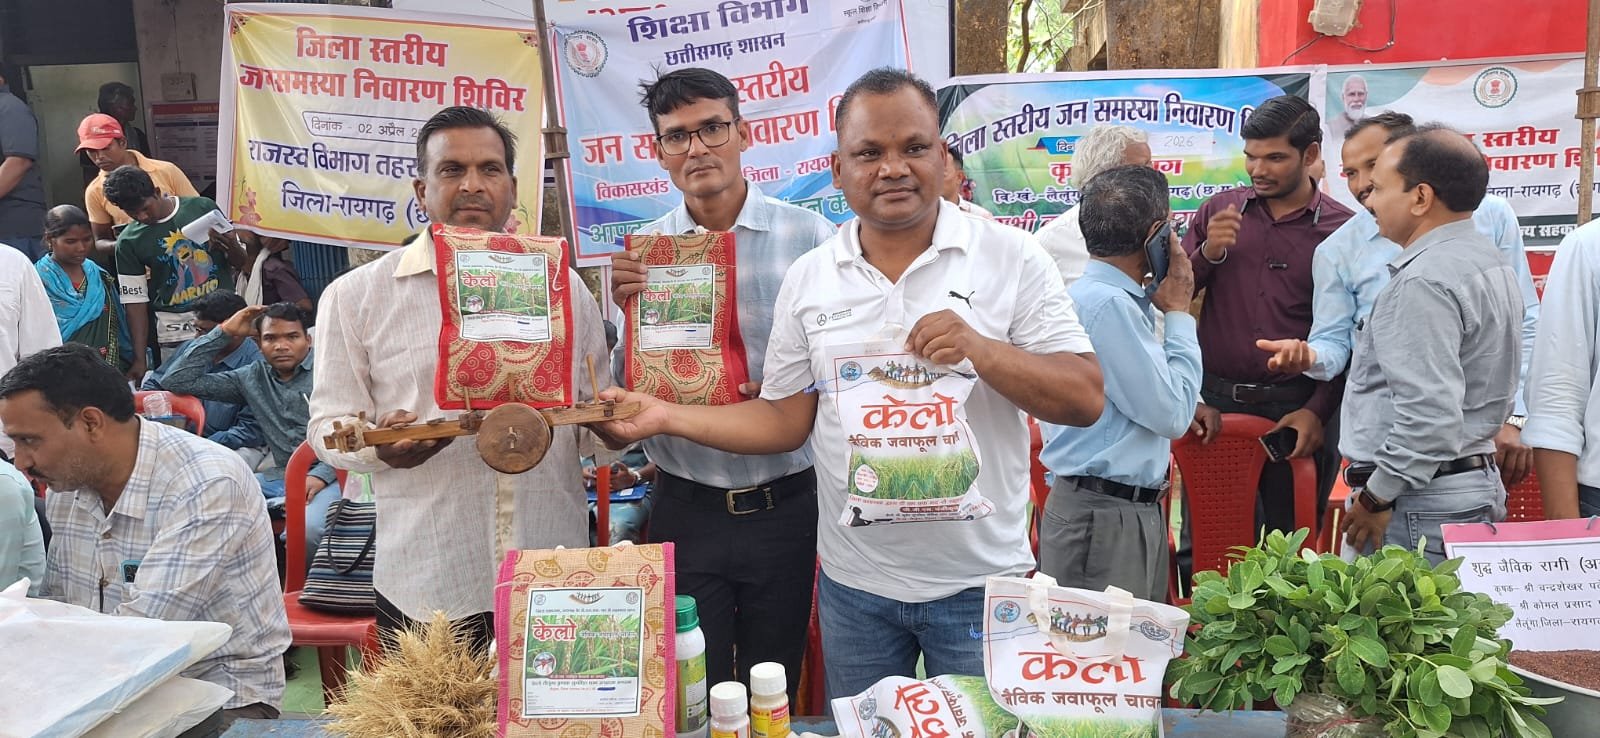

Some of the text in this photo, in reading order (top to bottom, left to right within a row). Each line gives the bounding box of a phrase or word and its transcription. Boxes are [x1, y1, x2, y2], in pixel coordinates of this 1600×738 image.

[626, 16, 711, 42] शिक्षा
[717, 0, 809, 28] विभाग
[296, 27, 449, 67] जिला स्तरीय
[664, 32, 787, 66] छत्तीसगढ़ शासन
[353, 68, 448, 105] निवारण
[453, 76, 528, 112] शिविर
[311, 116, 343, 132] दिनांक
[358, 123, 373, 134] 02
[378, 122, 405, 137] अप्रैल
[992, 103, 1051, 143] स्तरीय
[1056, 101, 1089, 126] जन
[1094, 99, 1159, 122] समस्या
[1164, 92, 1236, 133] निवारण
[1164, 135, 1195, 148] 2026
[1482, 126, 1560, 147] स्तरीय
[249, 139, 308, 168] राजस्व
[312, 143, 370, 174] विभाग
[581, 135, 622, 164] जन
[596, 177, 669, 200] विकासखंड
[281, 180, 396, 225] जिला-रायगढ़
[461, 271, 497, 288] केलो
[170, 279, 219, 305] NARUTO
[642, 286, 672, 302] केलो
[861, 392, 958, 430] केलो
[887, 436, 937, 452] जवाफूल
[1472, 562, 1493, 577] शुद्ध
[1497, 558, 1533, 573] जैविक
[1538, 556, 1570, 572] रागी
[1533, 599, 1560, 610] कोमल
[1564, 600, 1593, 609] प्रसाद
[533, 618, 577, 640] केलो
[1018, 642, 1147, 685] केलो
[1051, 691, 1118, 713] जवाफूल
